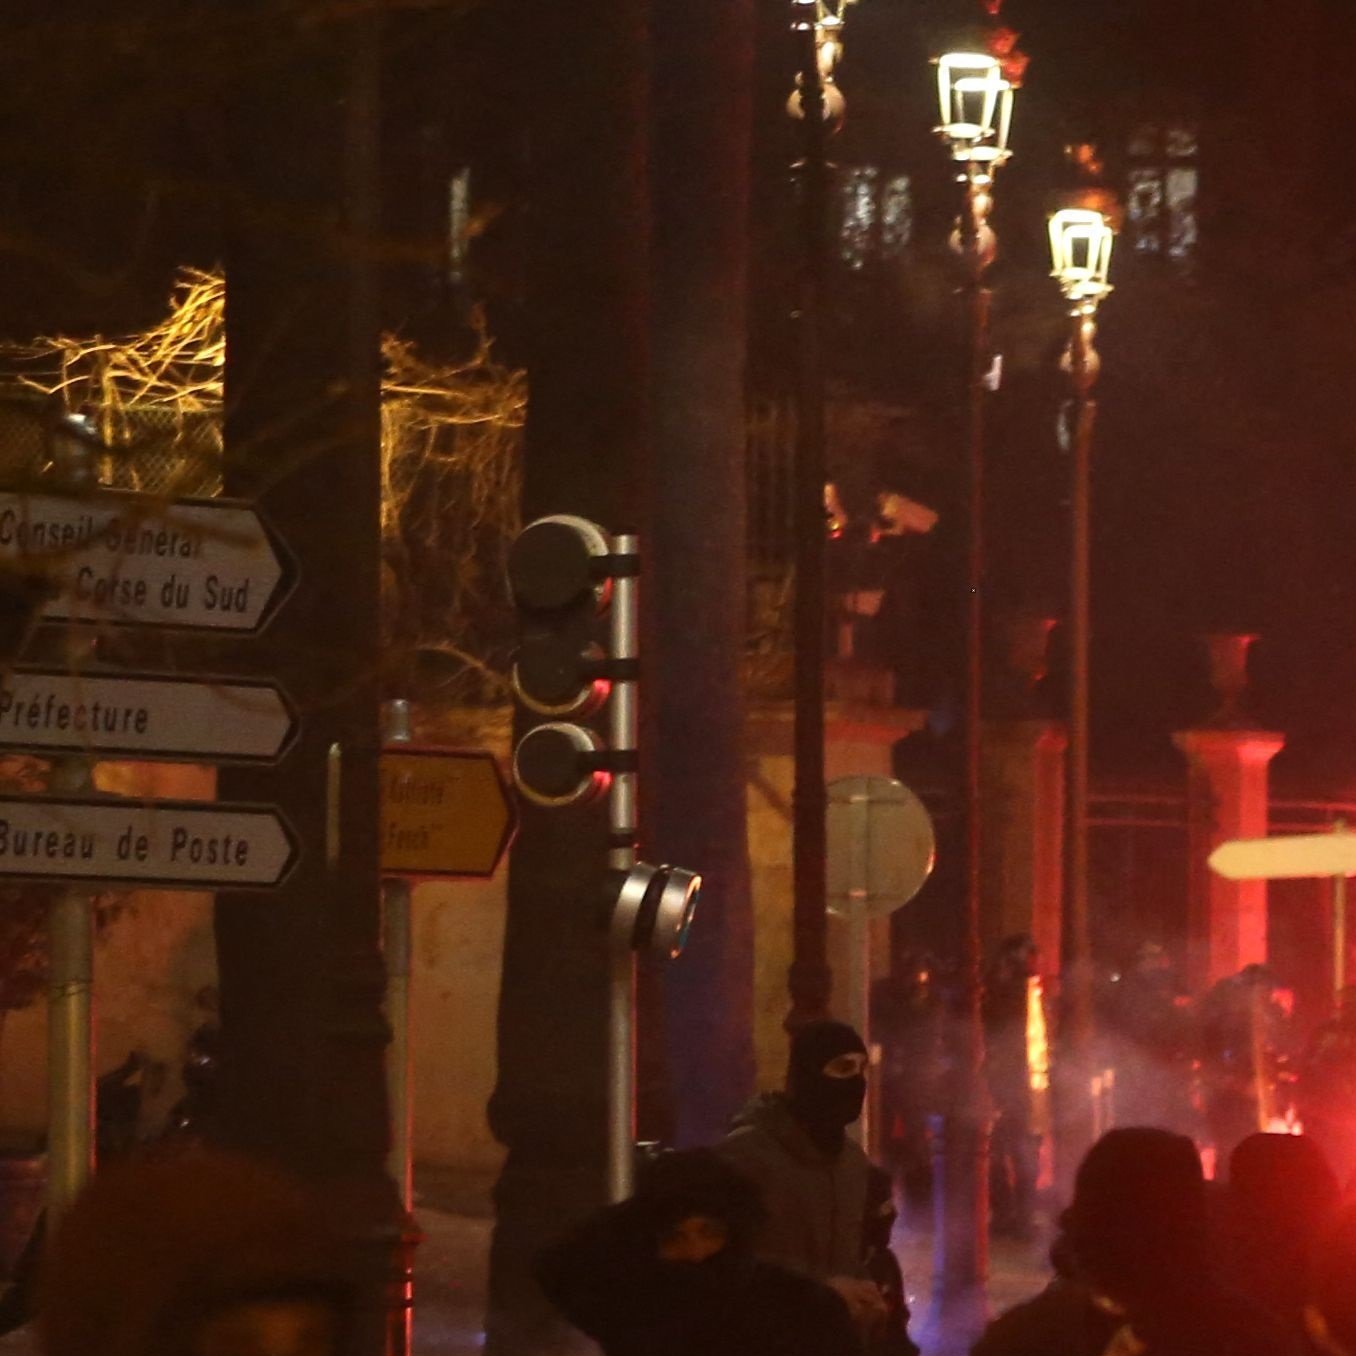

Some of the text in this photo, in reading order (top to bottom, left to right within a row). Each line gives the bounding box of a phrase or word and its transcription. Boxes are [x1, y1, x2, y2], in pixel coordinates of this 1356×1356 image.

[0, 509, 93, 547] Conseil
[77, 566, 250, 613] Corse du Sud
[0, 690, 148, 733] Préfecture
[0, 819, 249, 866] Bureau de Poste
